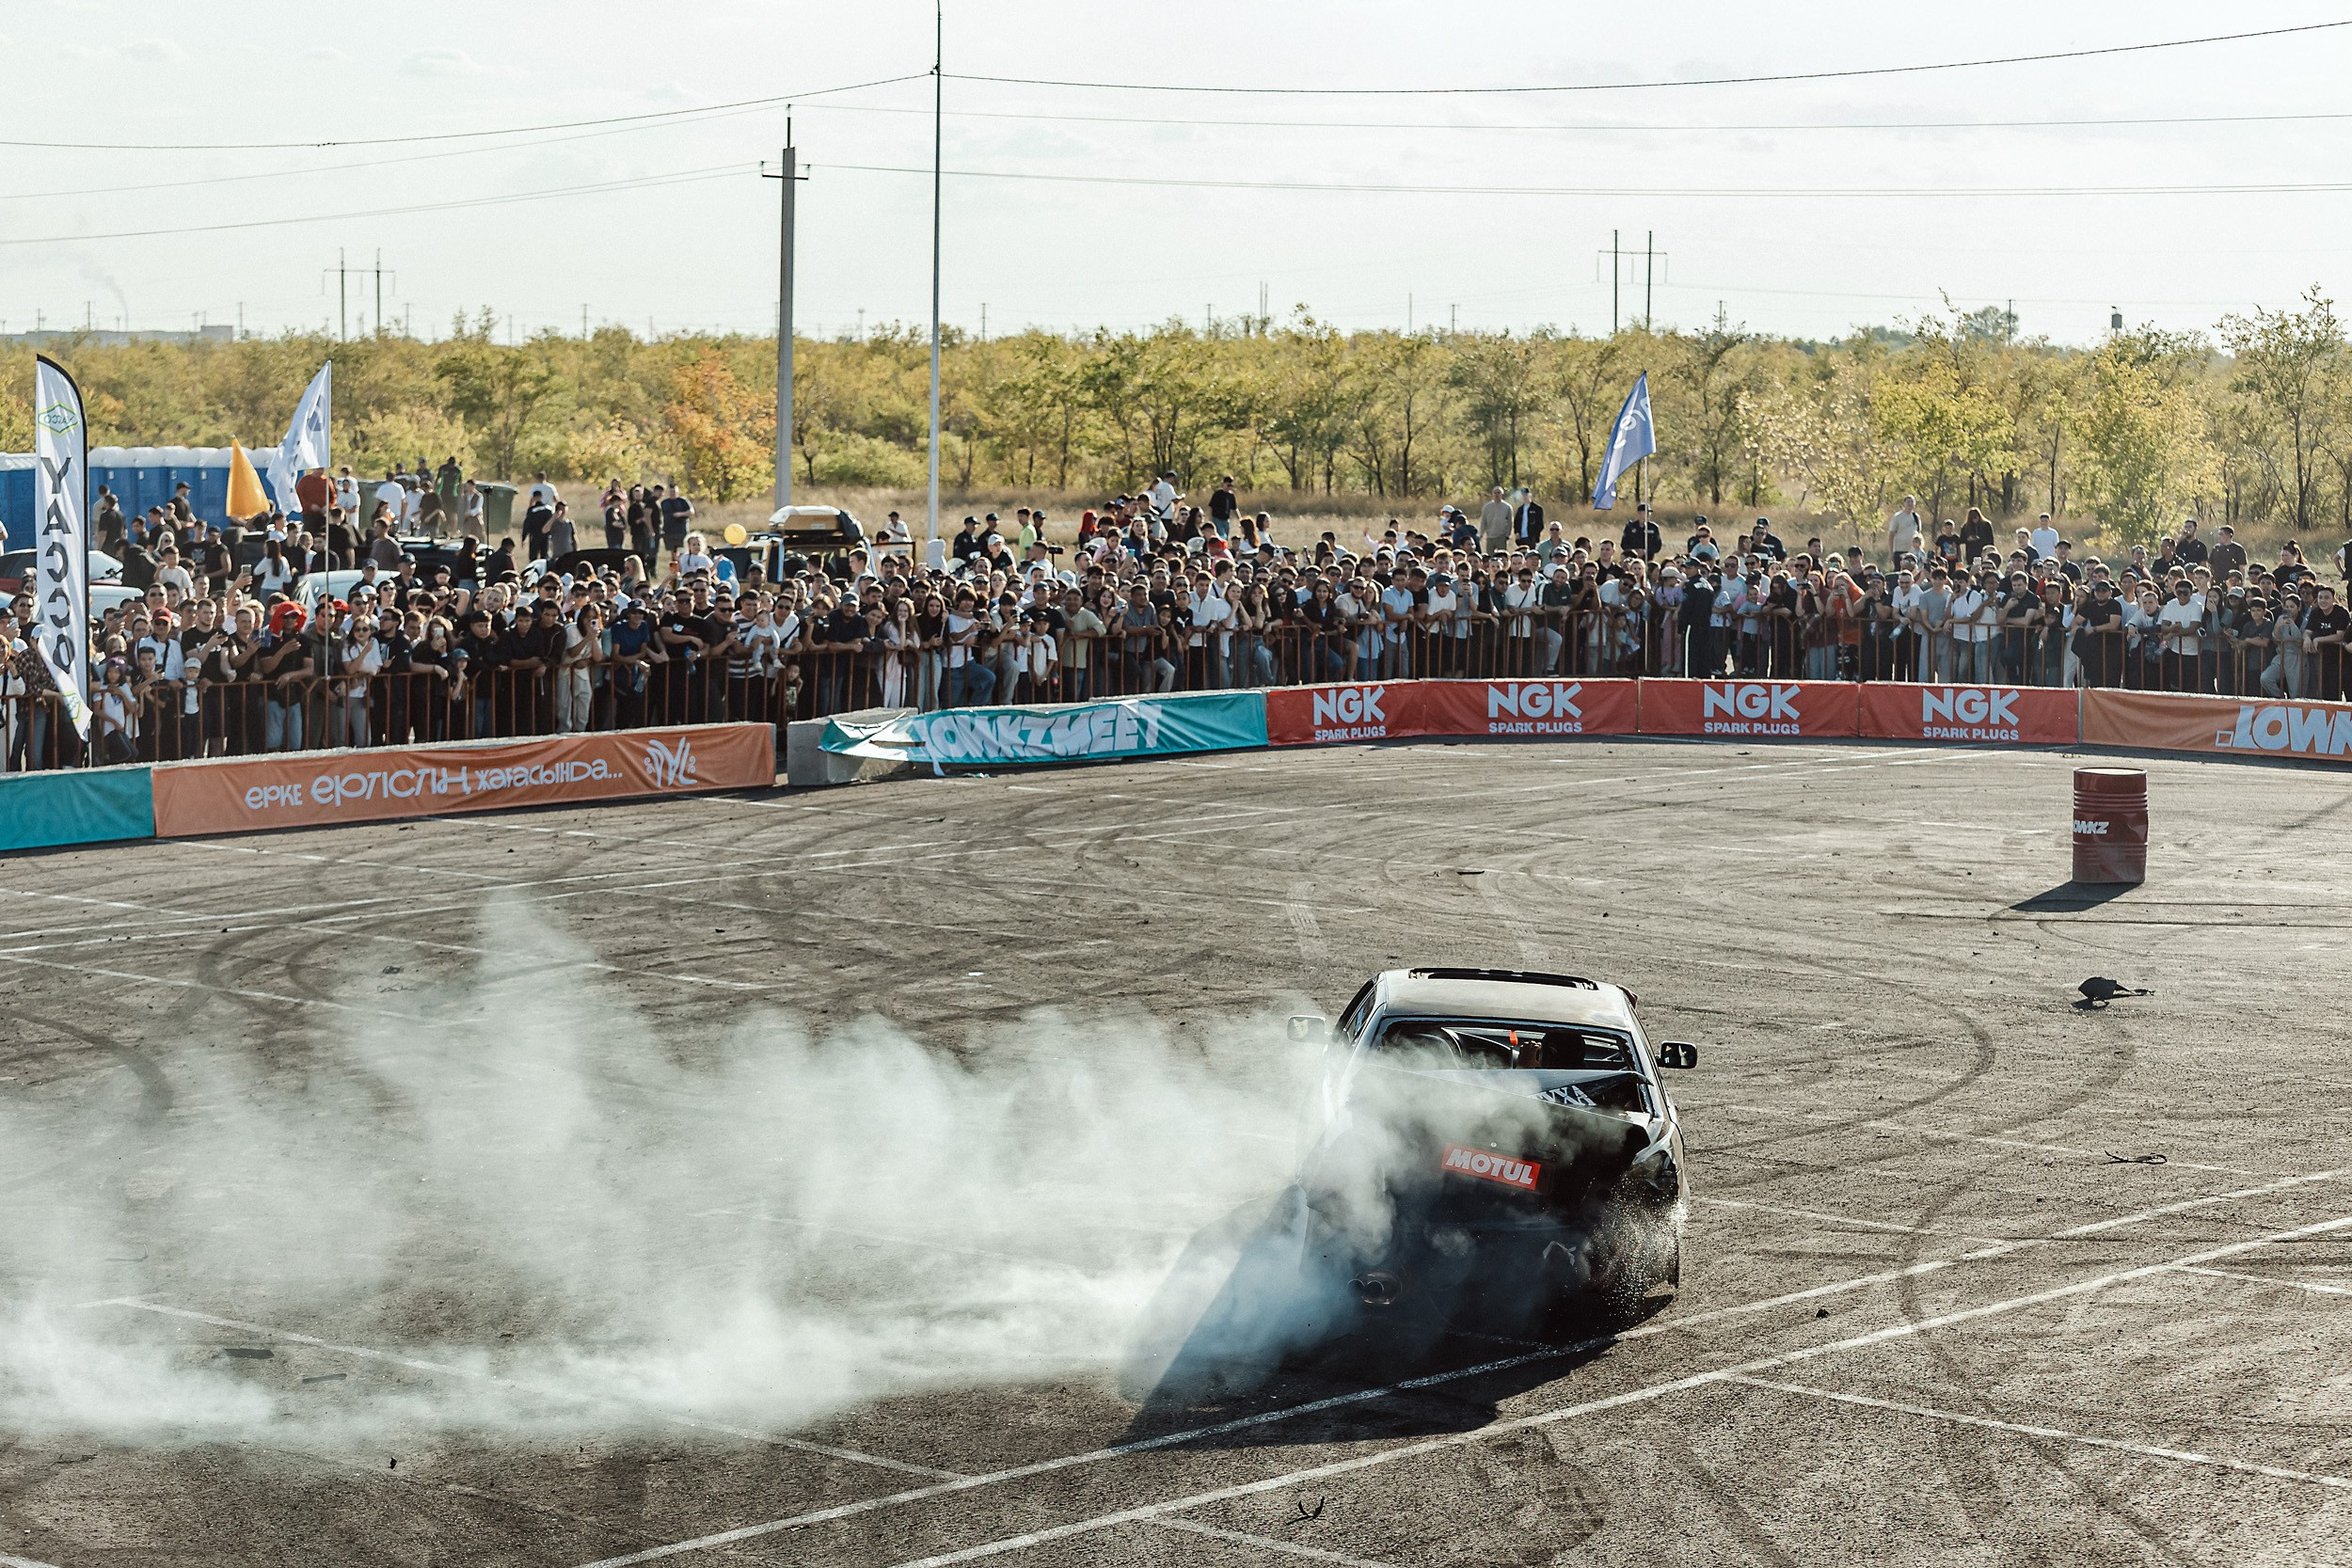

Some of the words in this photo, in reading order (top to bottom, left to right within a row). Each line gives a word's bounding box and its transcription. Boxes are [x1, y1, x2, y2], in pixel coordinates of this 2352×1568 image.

[1313, 685, 1386, 725] NGK
[1488, 683, 1582, 718] NGK
[1704, 684, 1801, 720] NGK
[1923, 689, 2020, 726] NGK
[1314, 728, 1349, 741] SPARK
[1350, 725, 1386, 739] PLUGS
[1488, 721, 1534, 734] SPARK
[1536, 721, 1582, 734] PLUGS
[1704, 721, 1750, 734] SPARK
[1753, 722, 1801, 735] PLUGS
[1923, 726, 1969, 739] SPARK
[1972, 728, 2020, 741] PLUGS
[1446, 1148, 1534, 1185] MOTUL
